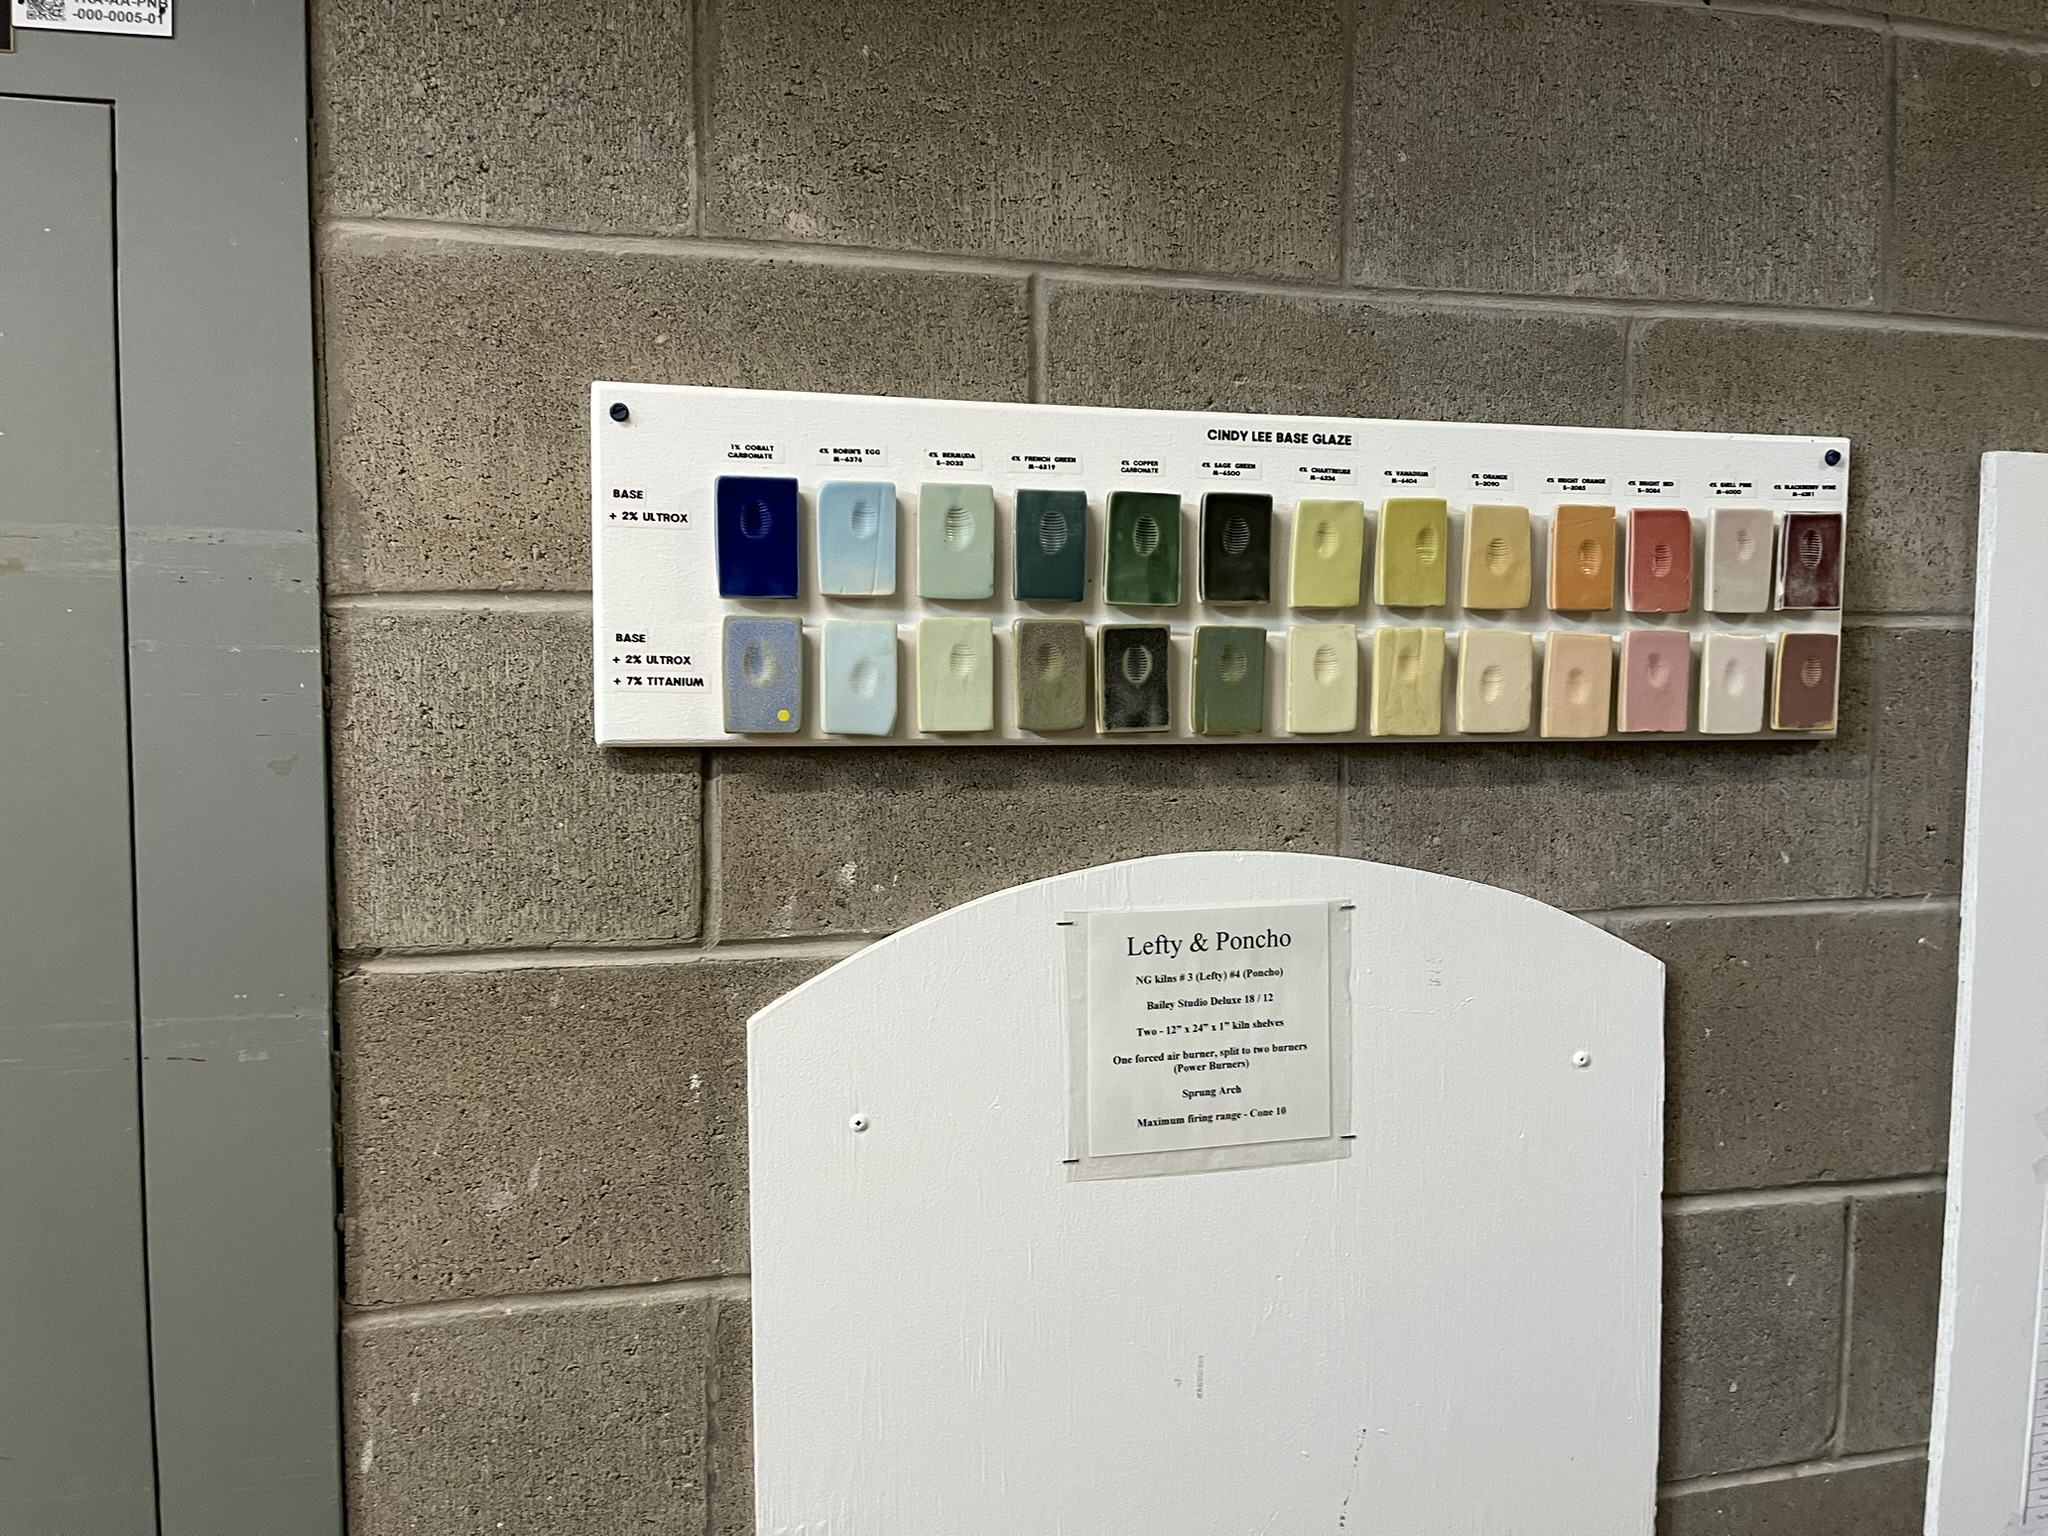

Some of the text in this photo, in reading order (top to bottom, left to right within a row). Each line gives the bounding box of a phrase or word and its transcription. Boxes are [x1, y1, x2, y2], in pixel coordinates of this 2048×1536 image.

[73, 8, 163, 24] -000-0005-01
[1208, 428, 1352, 446] CINDY LEE BASE GLAZE
[728, 452, 772, 460] CARBONATE
[942, 452, 976, 460] BERMUDA
[612, 488, 644, 500] BASE
[608, 510, 688, 524] + 2% ULTROX
[616, 634, 646, 642] BASE
[626, 654, 642, 664] 2%
[646, 654, 692, 666] ULTROX
[614, 676, 704, 686] + 7% TITANIUM
[1128, 928, 1292, 958] Lefty & Poncho
[1136, 976, 1152, 984] NG
[1154, 974, 1178, 984] kilns
[1188, 972, 1194, 982] 3
[1196, 970, 1228, 982] (Lefty)
[1230, 970, 1240, 978] #4
[1242, 968, 1284, 980] (Poncho)
[1146, 992, 1274, 1010] Bailey Studio Deluxe 18 / 12
[1136, 1028, 1158, 1036] Two
[1232, 1020, 1250, 1030] kiln
[1252, 1018, 1284, 1028] shelves
[1112, 1056, 1132, 1064] One
[1136, 1052, 1164, 1064] forced
[1166, 1052, 1180, 1060] air
[1182, 1050, 1218, 1060] burner,
[1220, 1046, 1240, 1058] split
[1272, 1044, 1308, 1052] burners
[1174, 1058, 1250, 1074] (Power Burners)
[1182, 1084, 1242, 1100] Sprung Arch
[1138, 1118, 1184, 1128] Maximum
[1188, 1114, 1214, 1124] firing
[1216, 1112, 1242, 1122] range
[1250, 1108, 1274, 1118] Cone
[1276, 1106, 1286, 1116] 10
